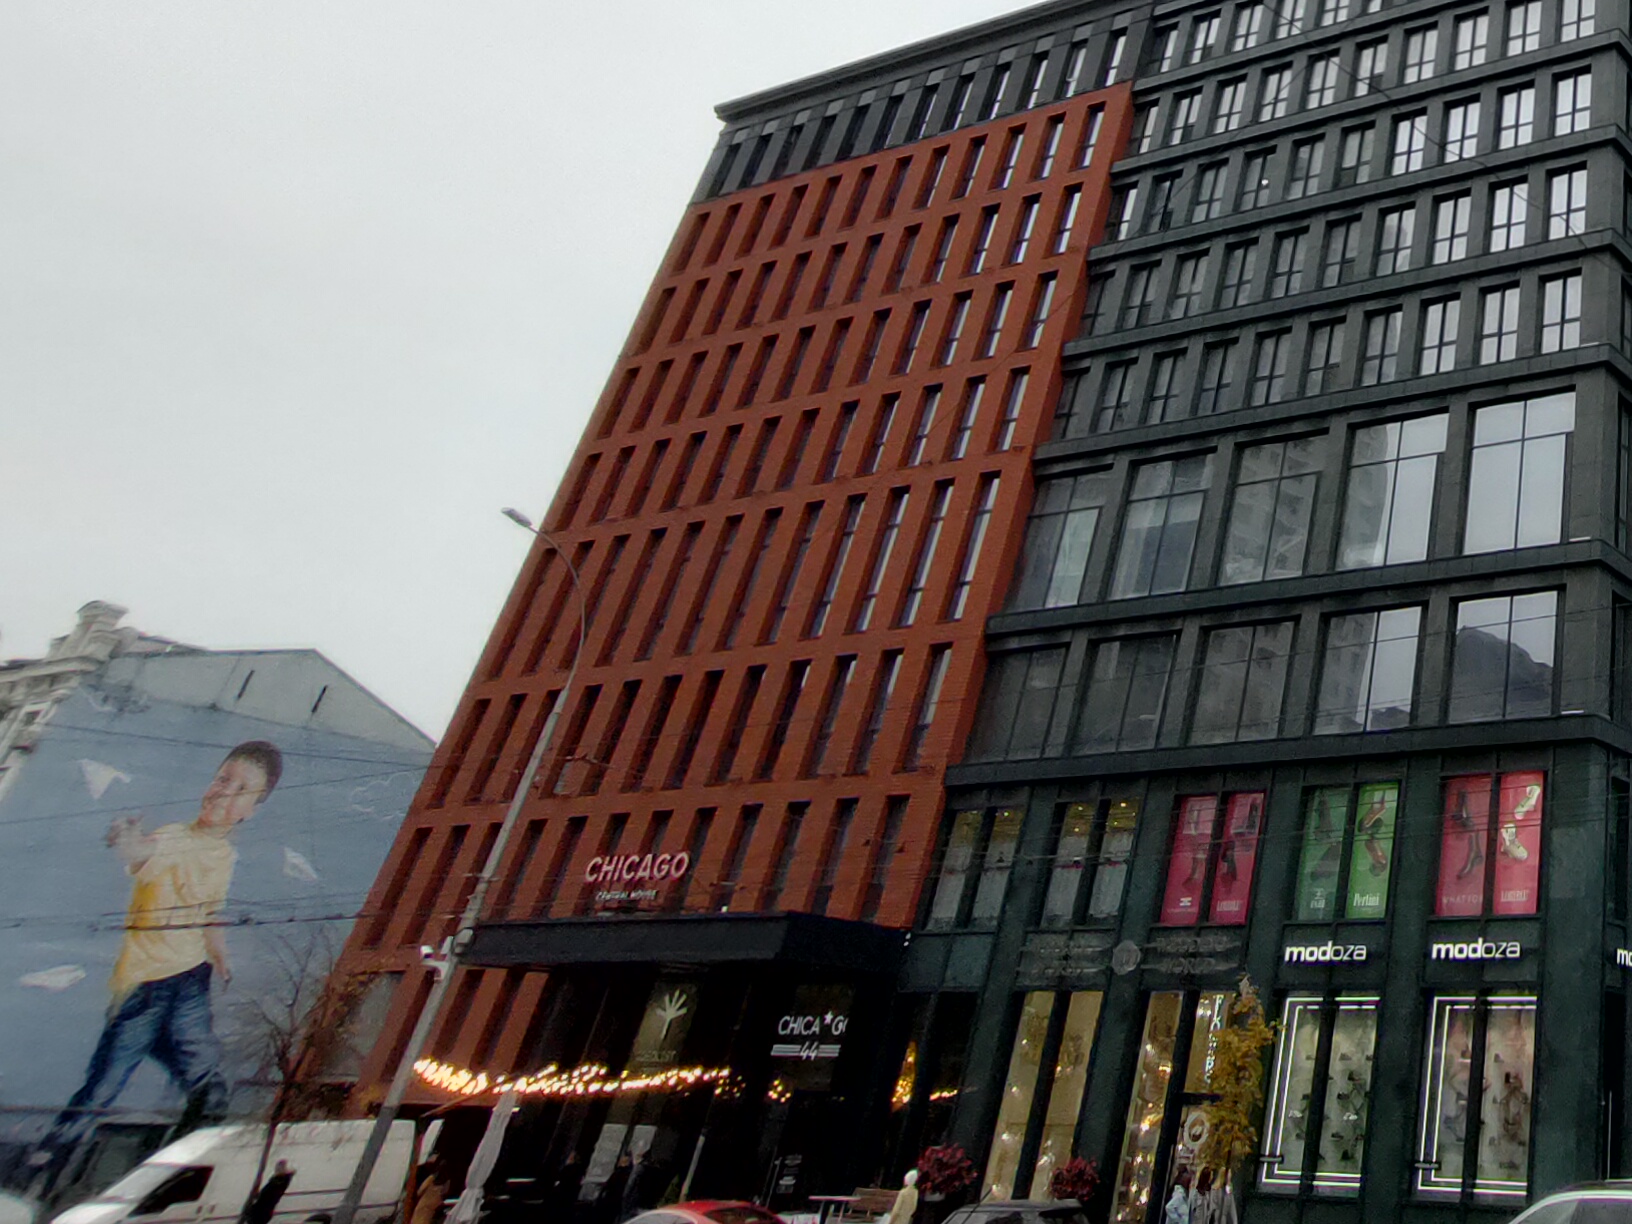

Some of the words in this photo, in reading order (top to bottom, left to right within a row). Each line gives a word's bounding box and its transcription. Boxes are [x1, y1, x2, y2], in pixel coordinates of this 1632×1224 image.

[585, 851, 690, 882] CHICAGO
[1283, 940, 1367, 963] modoza
[1431, 936, 1522, 961] modoza
[801, 1041, 820, 1061] 44
